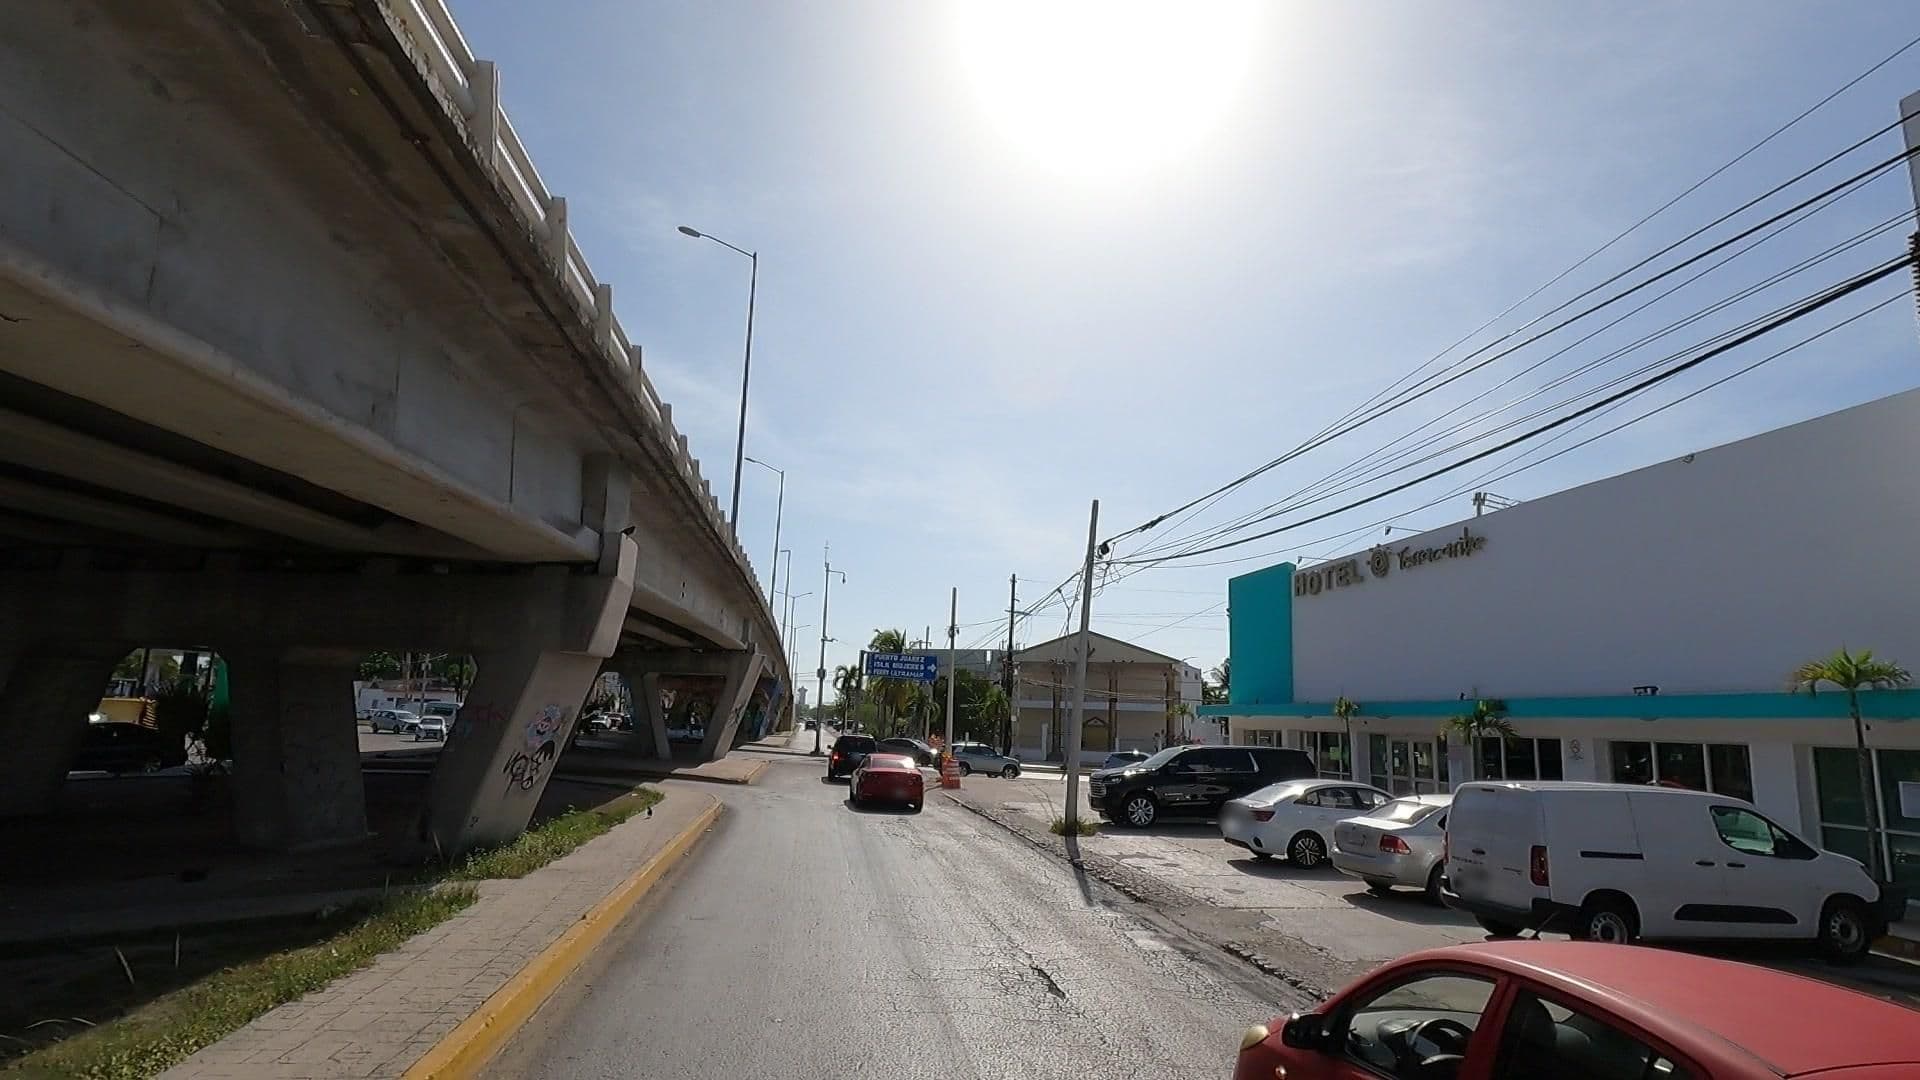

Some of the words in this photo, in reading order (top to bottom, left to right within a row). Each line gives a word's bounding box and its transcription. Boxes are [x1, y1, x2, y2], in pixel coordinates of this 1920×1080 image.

[1294, 559, 1364, 597] HOTEL
[892, 662, 924, 670] MUJERES
[891, 669, 924, 677] ULTRAMAR
